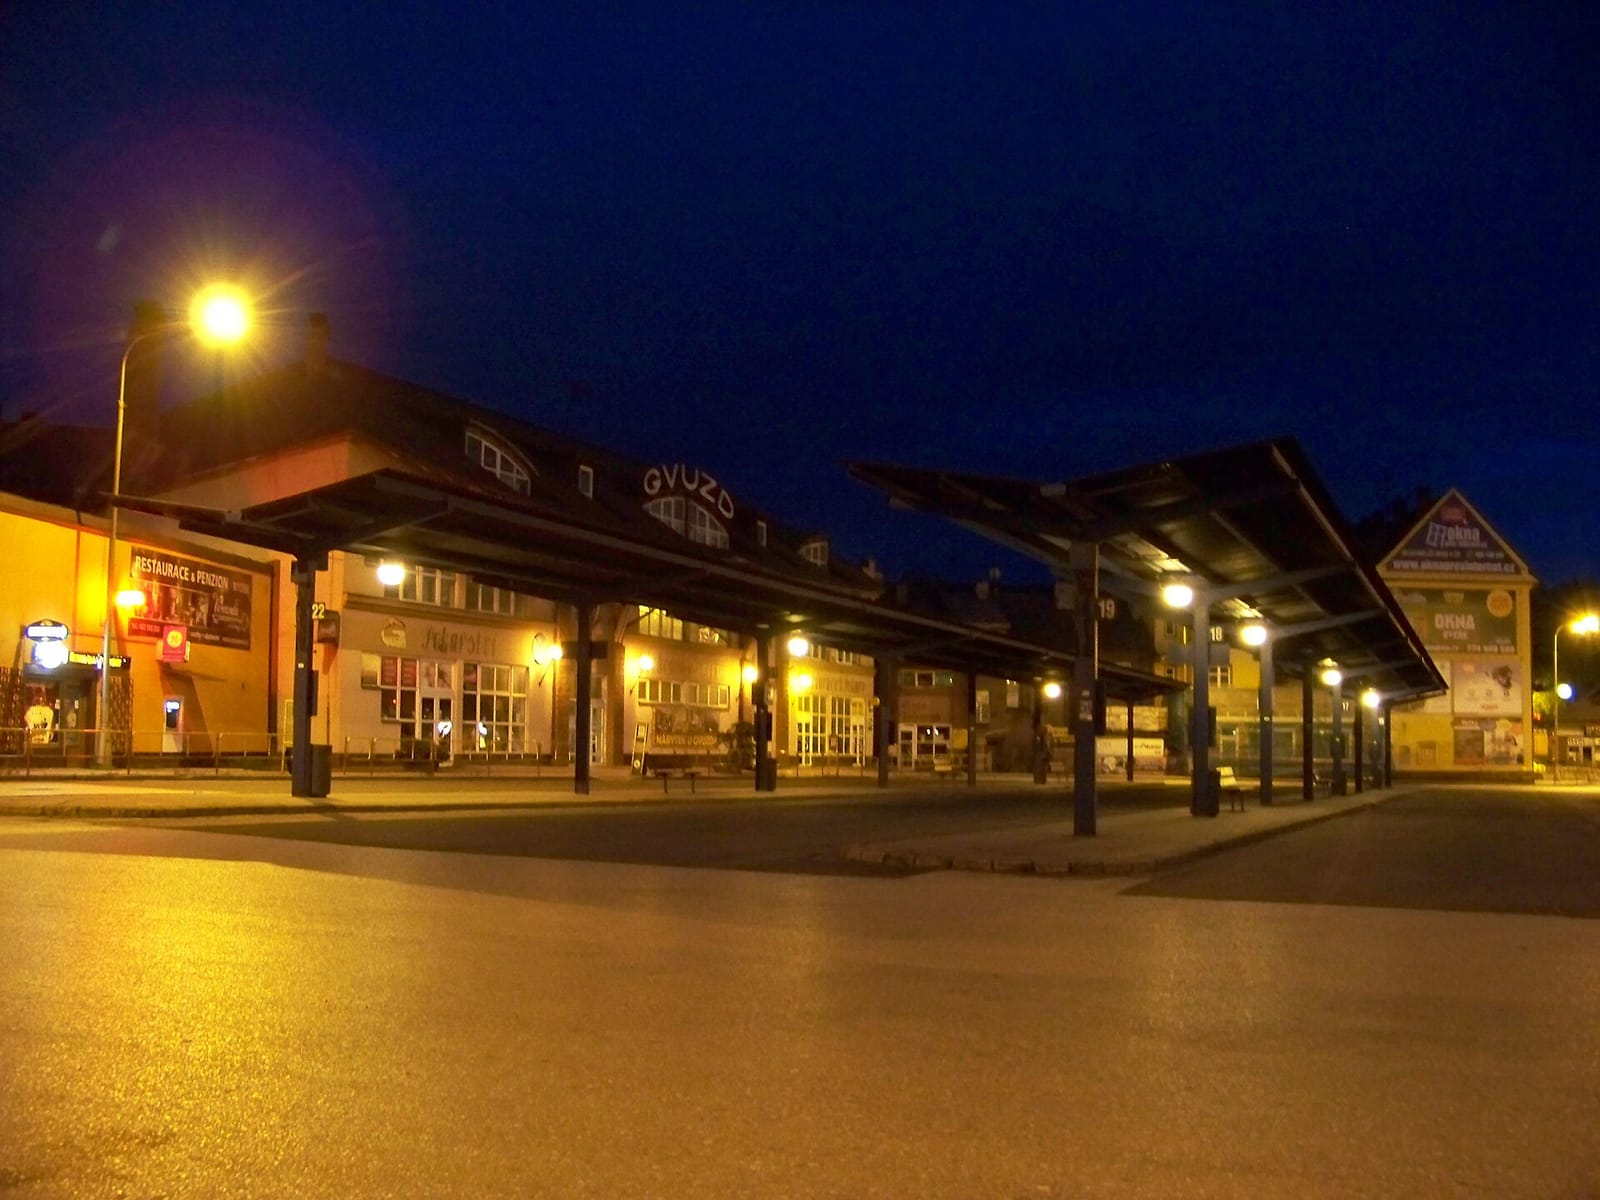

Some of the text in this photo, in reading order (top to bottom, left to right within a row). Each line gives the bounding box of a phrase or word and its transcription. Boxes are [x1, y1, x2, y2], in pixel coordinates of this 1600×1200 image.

[135, 556, 190, 582] RESTAURACE
[196, 570, 229, 590] PENZION
[312, 603, 325, 620] 22
[1098, 599, 1116, 620] 19
[1434, 613, 1476, 631] OKNA
